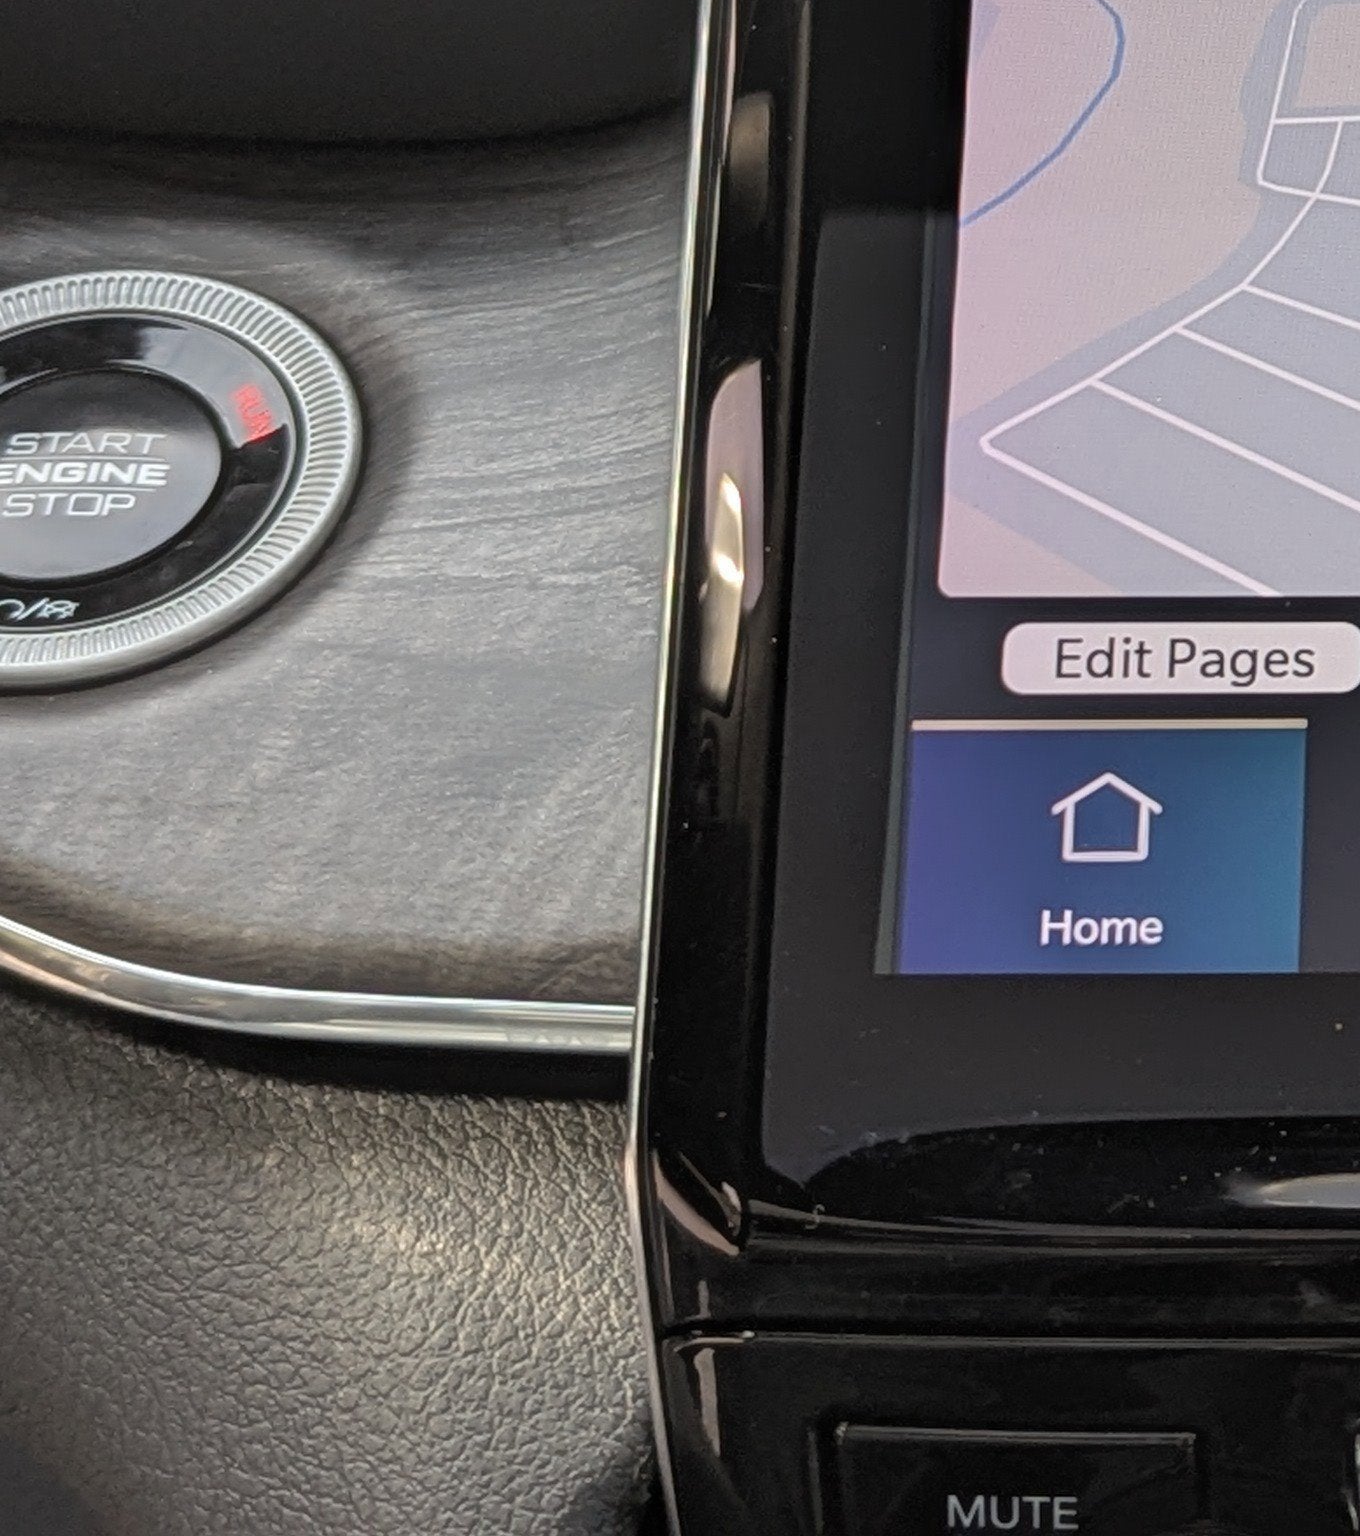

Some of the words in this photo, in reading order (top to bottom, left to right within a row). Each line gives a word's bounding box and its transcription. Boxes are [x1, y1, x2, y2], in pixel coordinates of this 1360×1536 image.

[5, 431, 168, 455] START
[3, 492, 136, 517] STOP
[1055, 638, 1152, 679] Edit
[1167, 638, 1315, 687] Pages
[1039, 909, 1163, 946] Home
[947, 1494, 1079, 1530] MUTE
